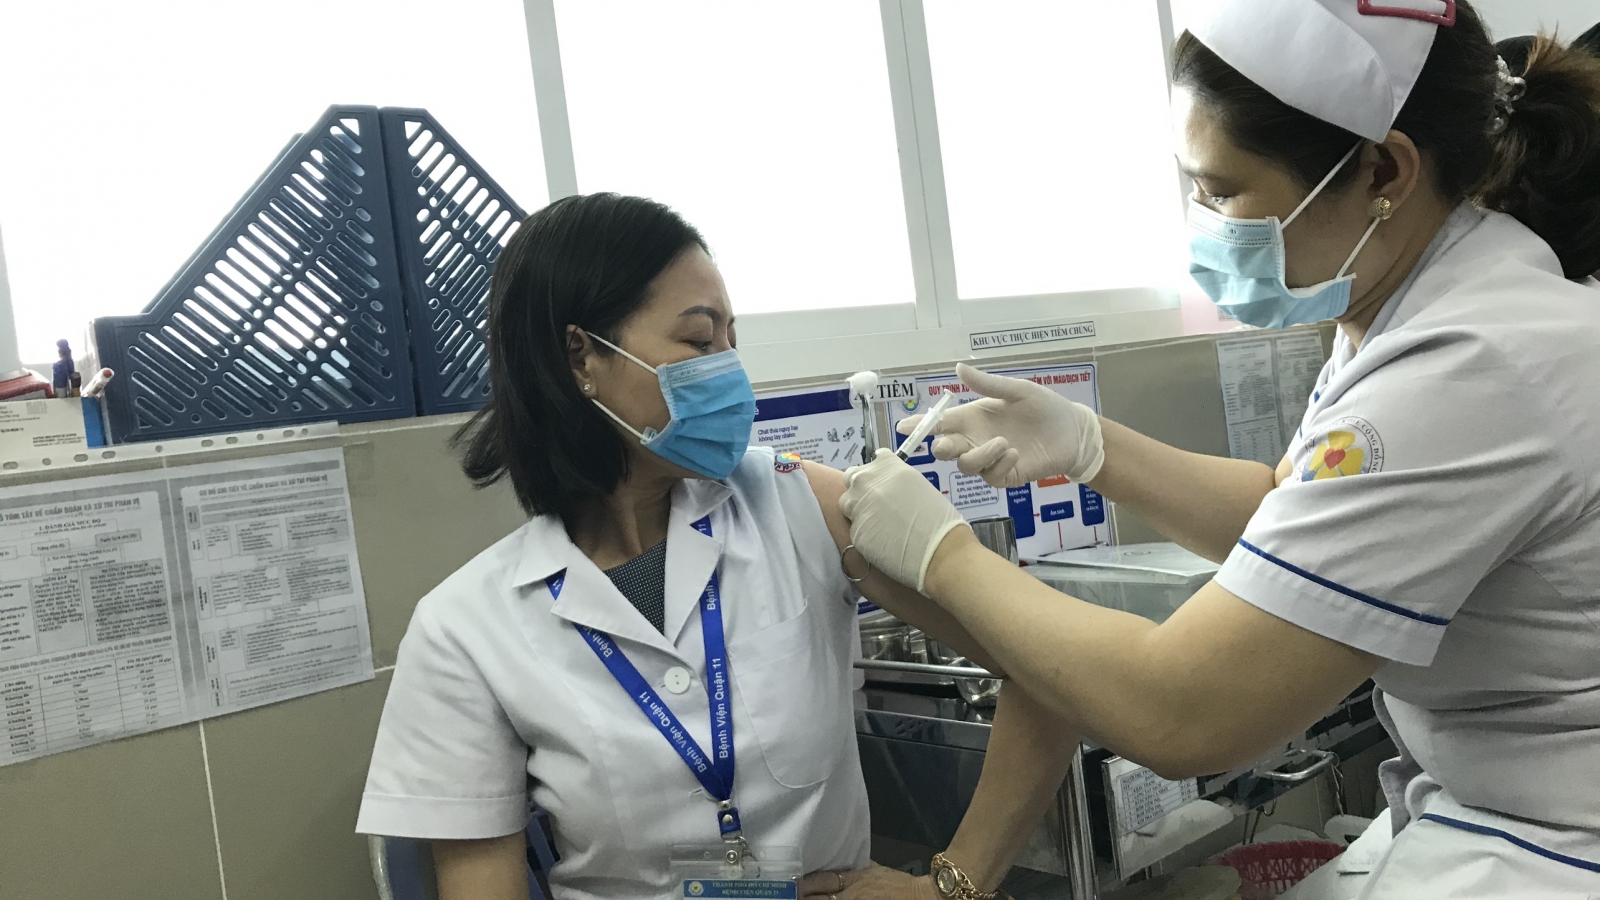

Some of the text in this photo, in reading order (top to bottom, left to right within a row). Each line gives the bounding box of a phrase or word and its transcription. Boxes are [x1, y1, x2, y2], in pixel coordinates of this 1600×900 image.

[973, 324, 1093, 346] KHU VỰC THỰC HIỆN TIÊM CHỦNG
[1080, 370, 1091, 381] TIẾT
[877, 379, 914, 399] TIÊM
[929, 385, 940, 396] QUY
[552, 578, 562, 591] 11
[706, 584, 717, 611] Bệnh
[592, 632, 613, 658] Bệnh
[712, 658, 730, 759] Bệnh Viện Quận 11
[639, 691, 707, 773] Bệnh Viện Quận 11
